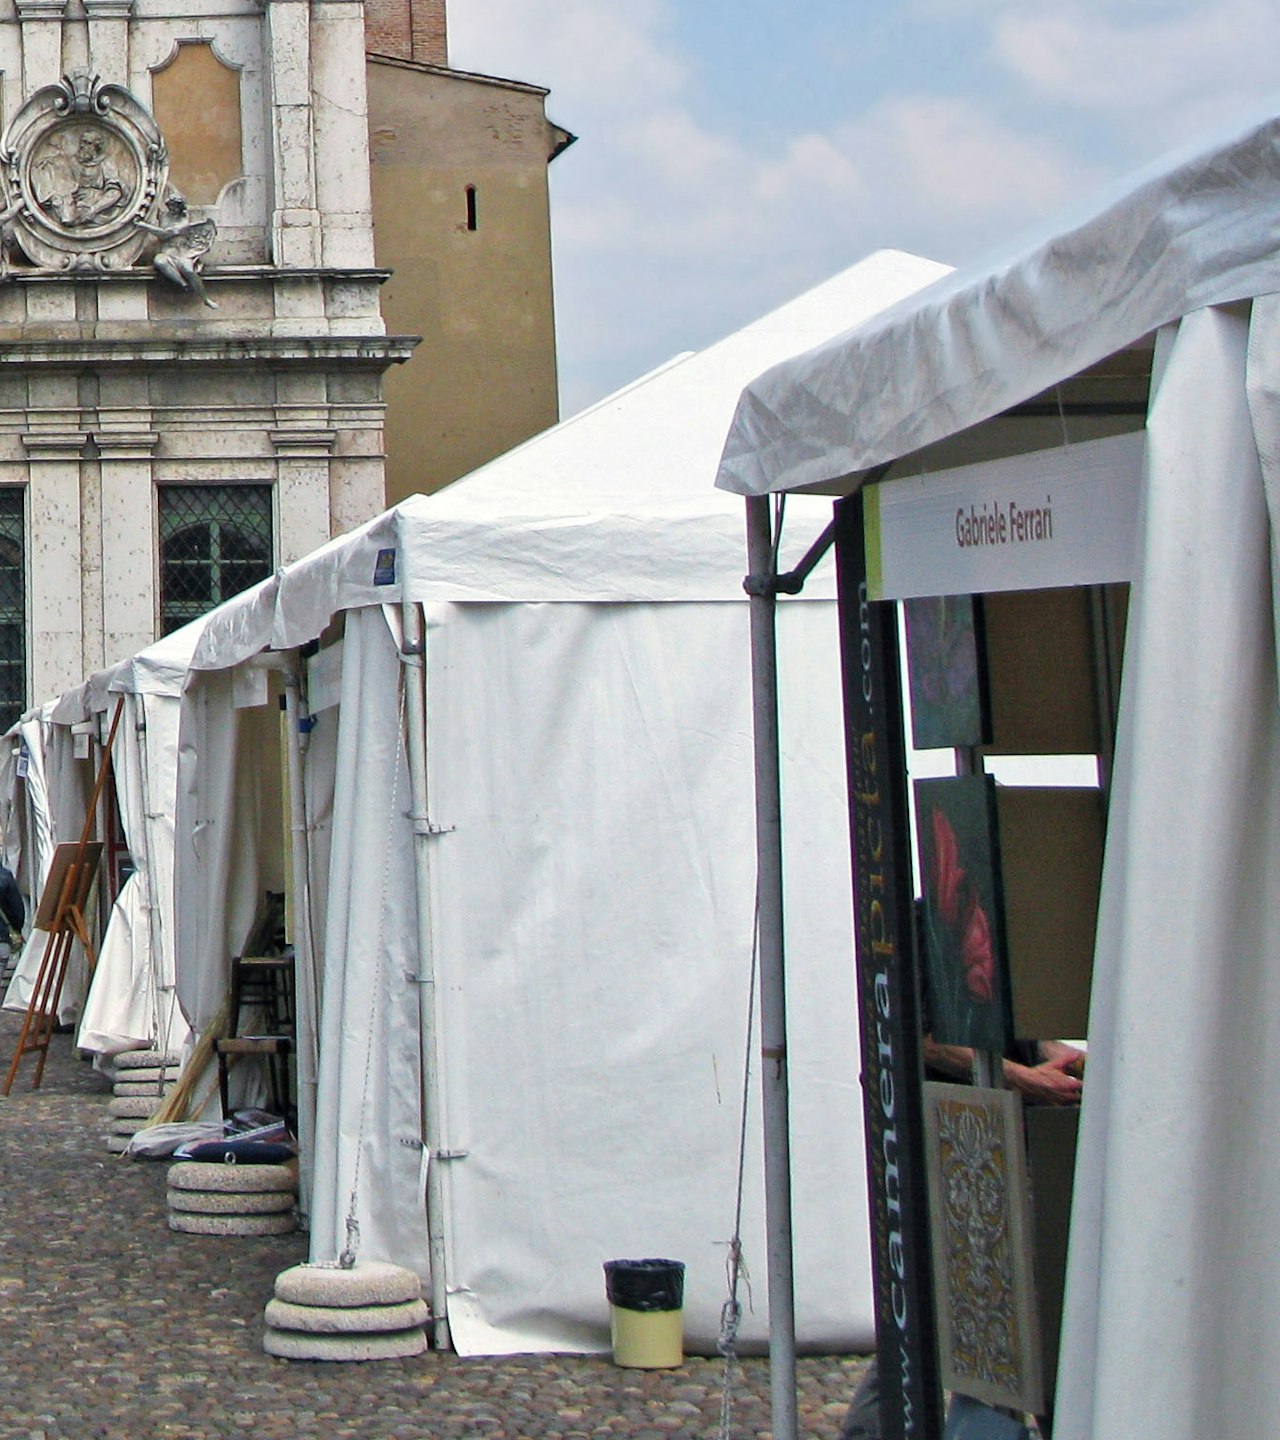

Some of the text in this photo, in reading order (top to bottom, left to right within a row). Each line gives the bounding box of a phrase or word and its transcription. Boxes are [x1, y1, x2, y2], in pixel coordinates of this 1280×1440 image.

[956, 495, 1053, 547] Gabriele Ferrari
[853, 580, 913, 1440] ww.camerapicta.com
